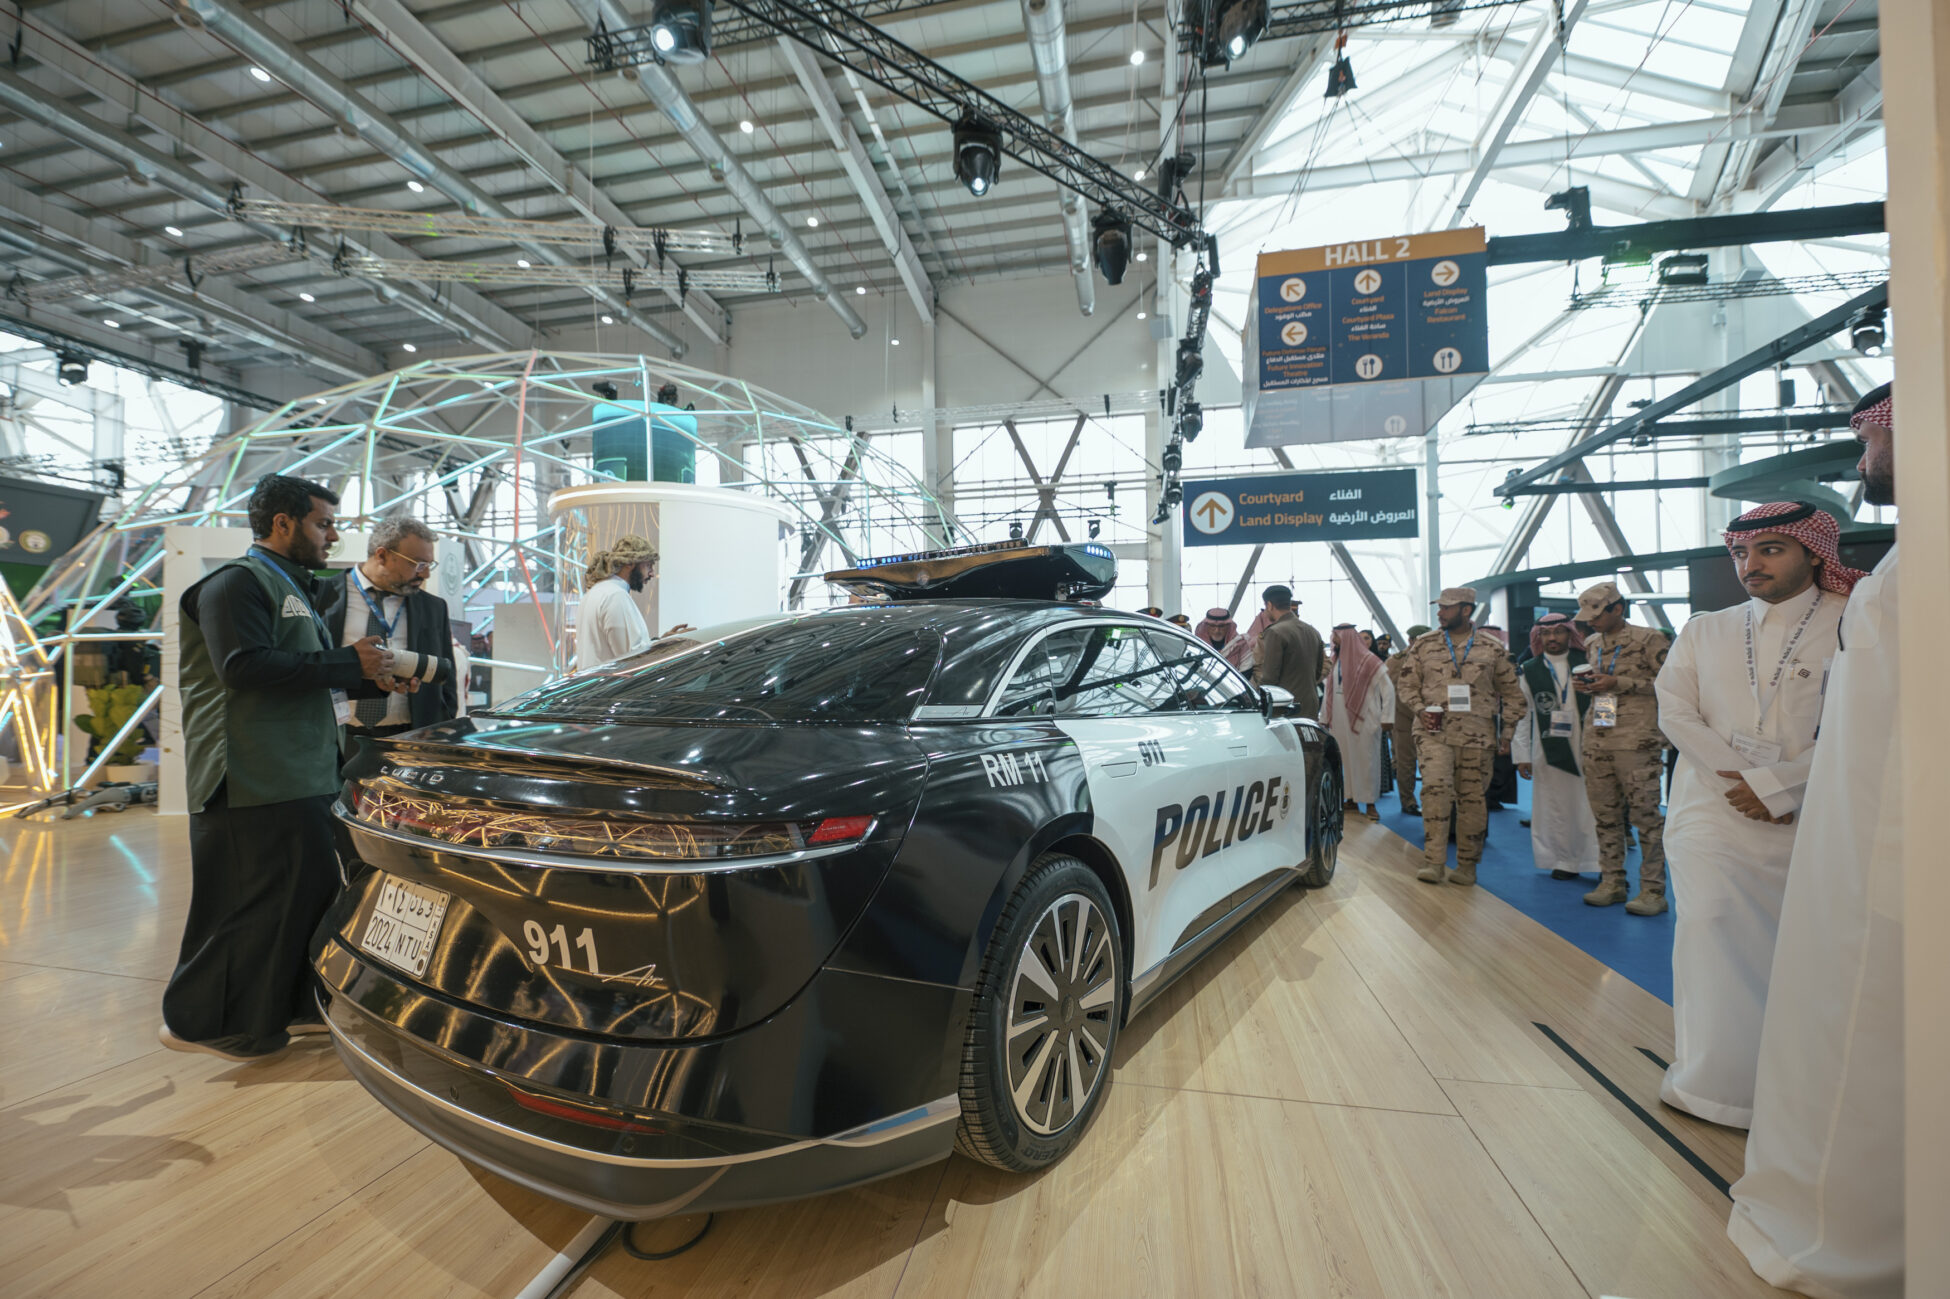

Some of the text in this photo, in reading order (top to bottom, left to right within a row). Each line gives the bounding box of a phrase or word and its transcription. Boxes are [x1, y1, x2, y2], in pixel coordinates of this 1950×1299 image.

[1324, 238, 1410, 266] HALL 2
[1239, 490, 1304, 506] Courtyard
[1328, 489, 1362, 501] الفناء
[1239, 511, 1324, 527] Land Display
[1328, 509, 1415, 525] العروض الأرضية
[1137, 738, 1166, 767] 911
[980, 751, 1049, 788] RM 11
[1147, 776, 1282, 892] POLICE
[364, 915, 422, 960] 2024 NTU
[523, 919, 599, 974] 911
